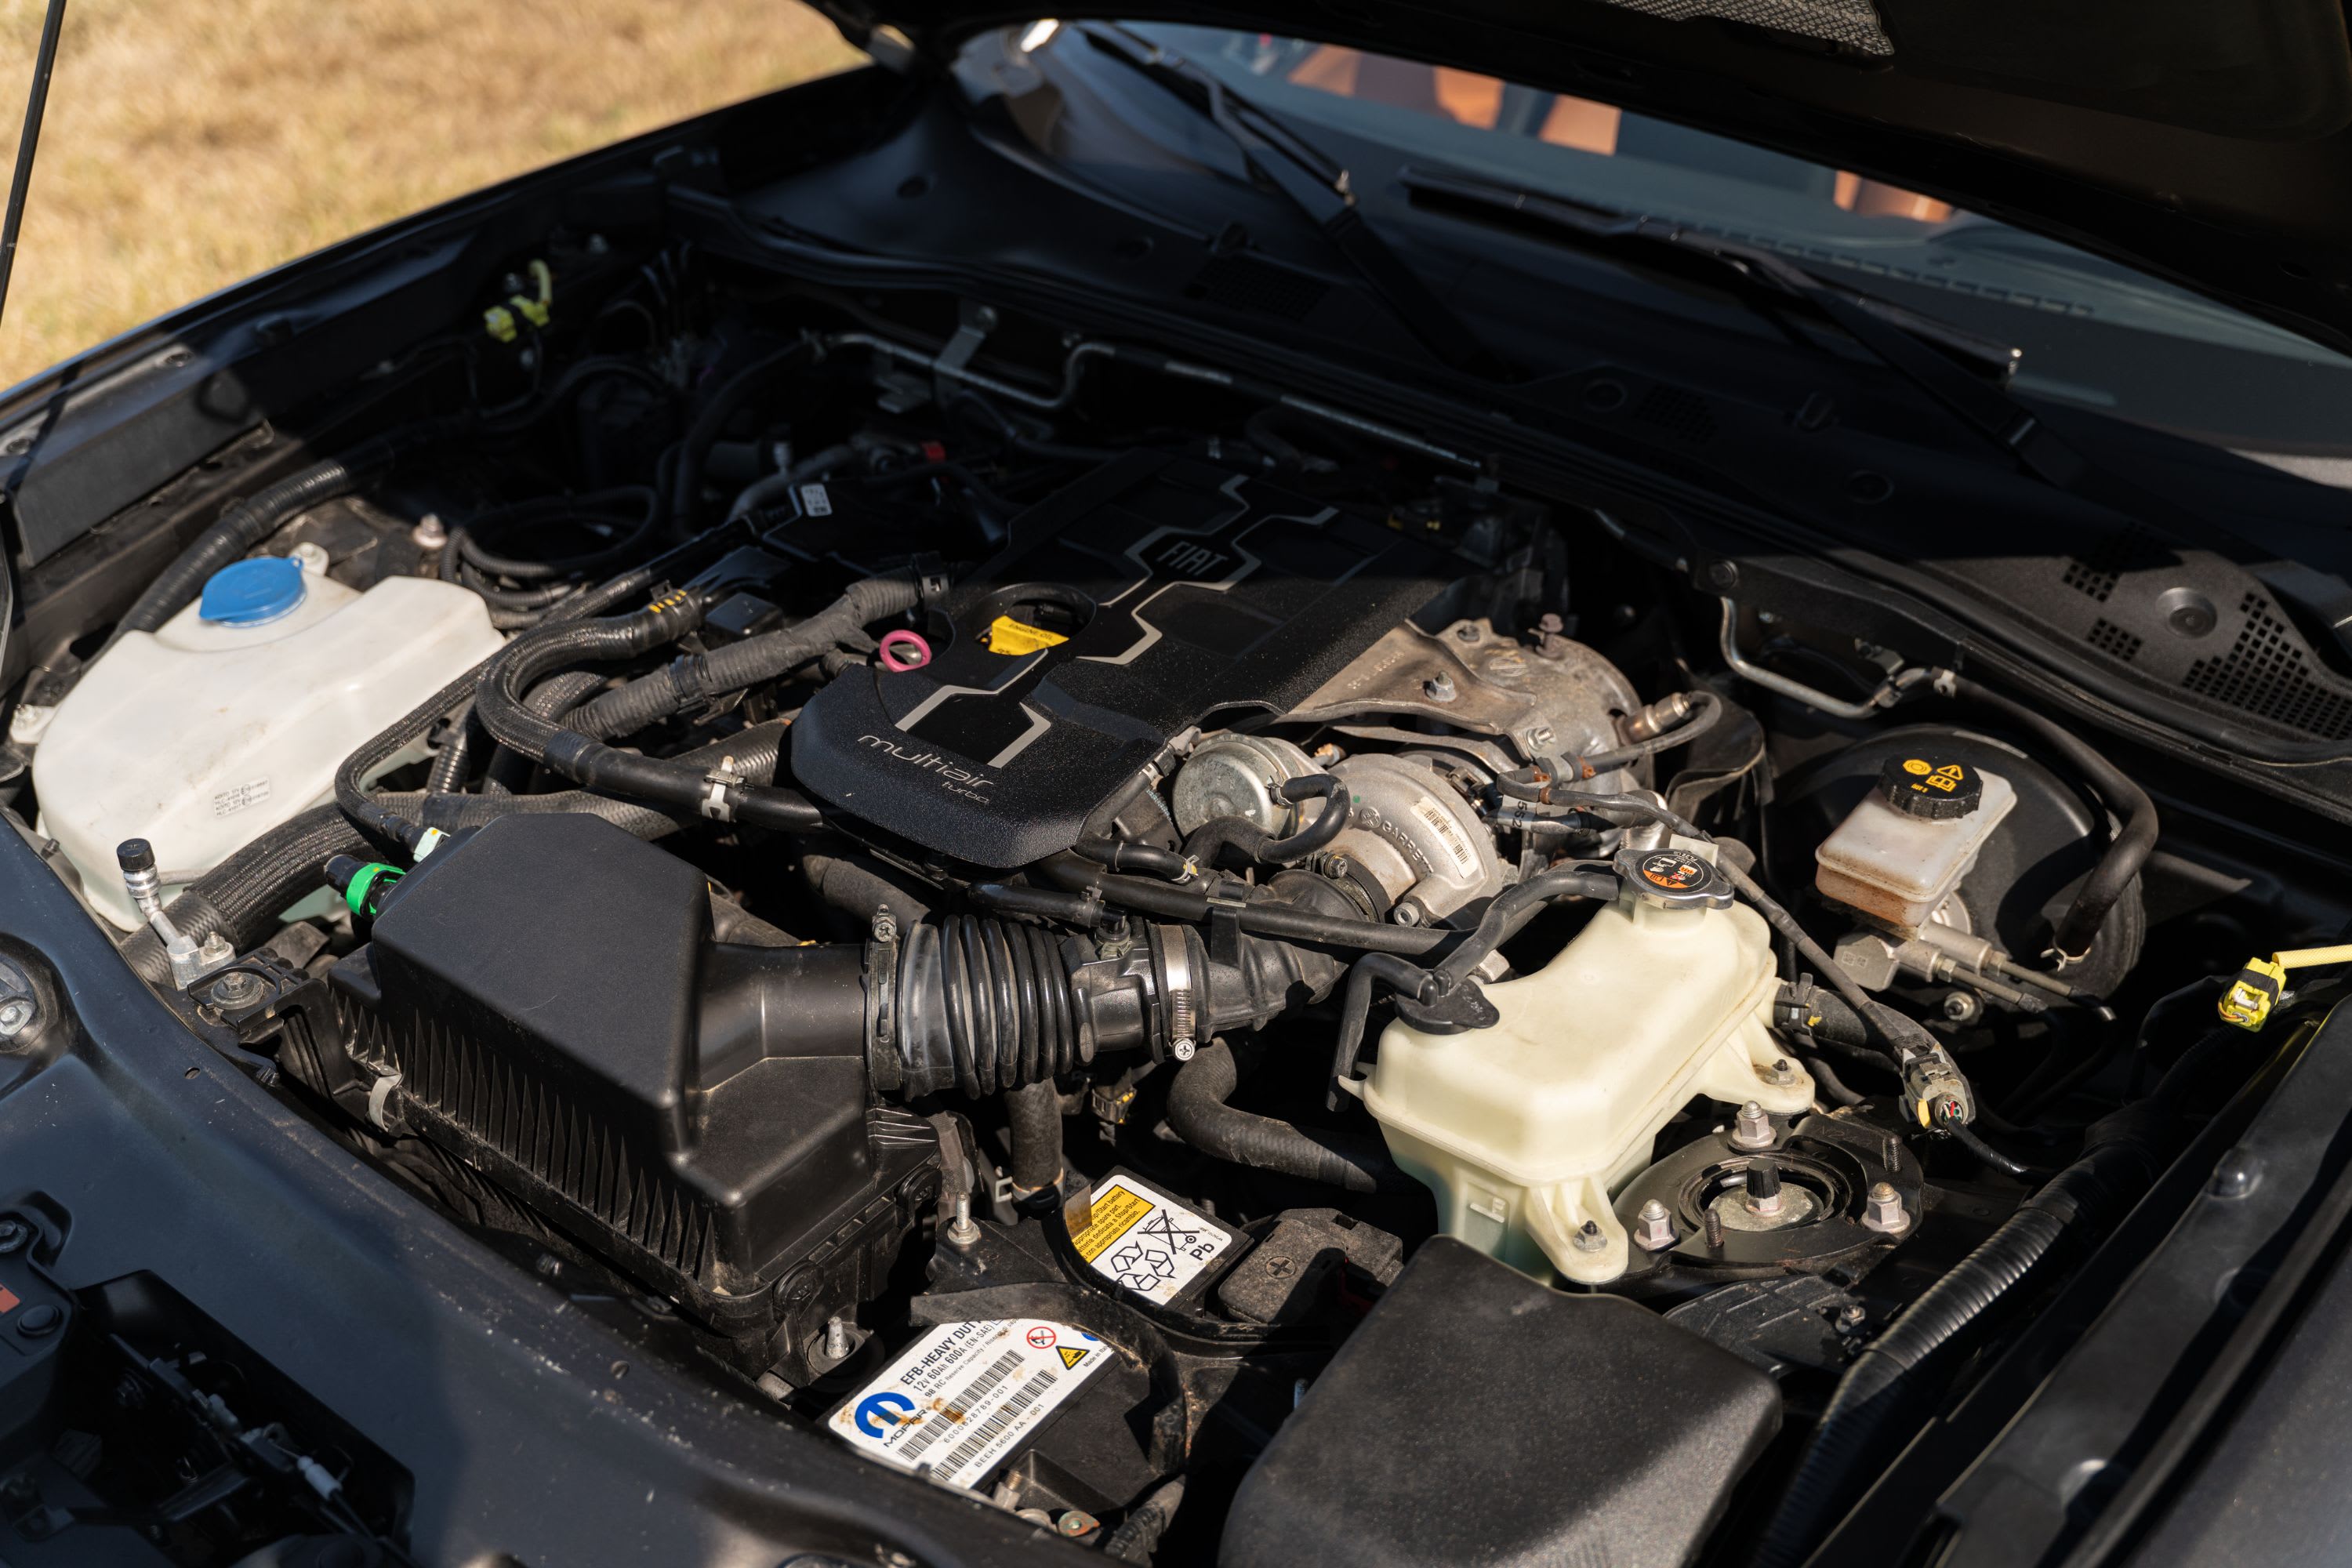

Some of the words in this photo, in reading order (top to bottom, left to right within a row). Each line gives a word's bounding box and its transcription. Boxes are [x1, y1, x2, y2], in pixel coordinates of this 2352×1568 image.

[1156, 541, 1229, 575] FIAT
[857, 735, 994, 787] multiair
[942, 781, 989, 804] turbo
[1512, 800, 1528, 828] 552
[1382, 820, 1434, 876] GARRETT
[1107, 1190, 1126, 1204] battery
[1074, 1223, 1098, 1245] appropriate
[1098, 1212, 1112, 1225] spare
[1109, 1204, 1122, 1216] part.
[1077, 1239, 1094, 1253] atteria
[1093, 1221, 1114, 1240] dedicata
[1115, 1198, 1141, 1219] Stop/Start
[1086, 1247, 1097, 1256] con
[1094, 1227, 1120, 1249] appropriato
[1119, 1210, 1141, 1229] ricambio.
[1189, 1243, 1215, 1261] Pb
[900, 1336, 956, 1386] EFB-HEAVY
[953, 1320, 982, 1340] DUT
[924, 1388, 936, 1398] 98
[935, 1379, 946, 1389] RC
[946, 1364, 965, 1381] Reserve
[963, 1348, 985, 1365] Capacity
[928, 1363, 949, 1381] 60Ah
[944, 1346, 967, 1365] 600A
[964, 1324, 995, 1348] (EN-SAE)
[1083, 1356, 1097, 1367] Made
[975, 1450, 996, 1468] BEEH
[996, 1431, 1015, 1448] 5600
[1014, 1421, 1026, 1432] AA
[1030, 1403, 1045, 1418] 001
